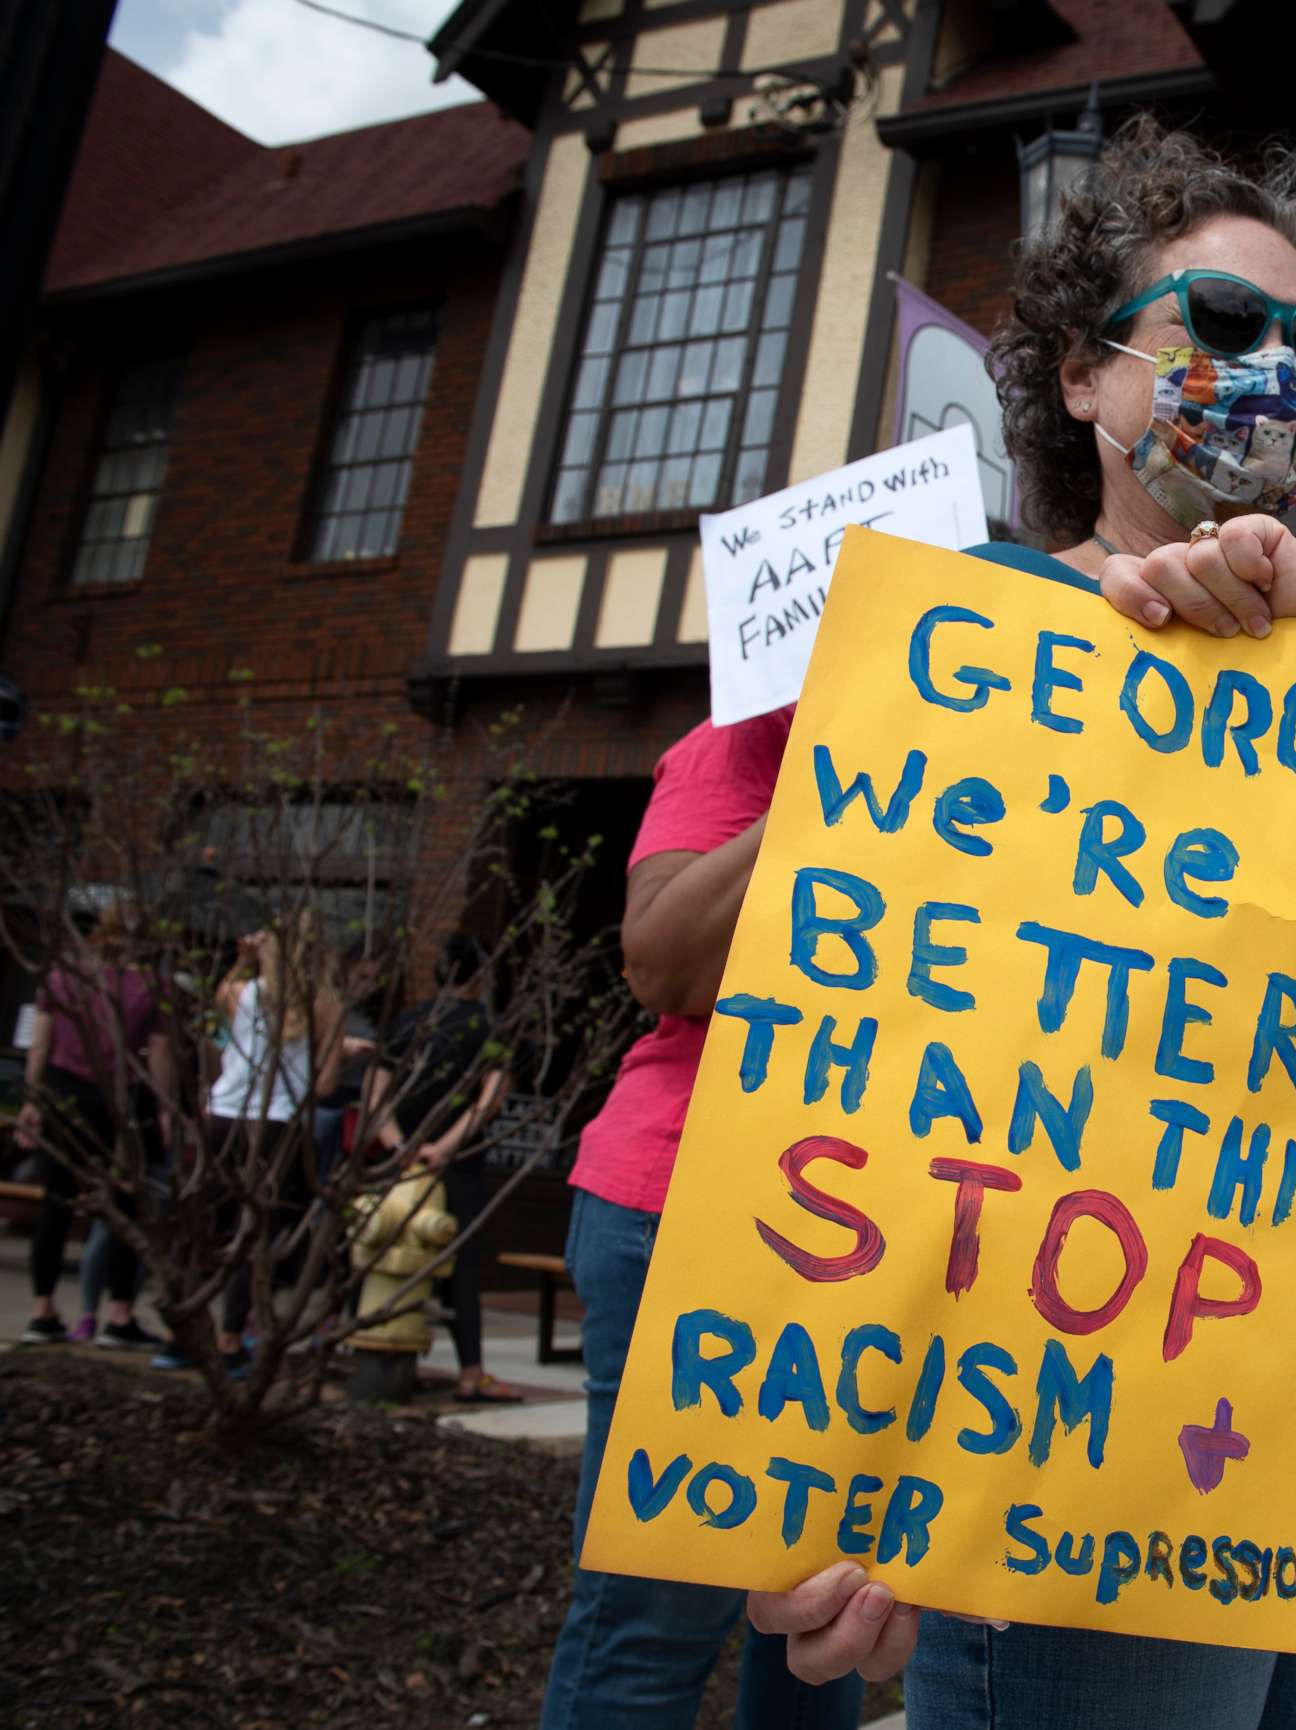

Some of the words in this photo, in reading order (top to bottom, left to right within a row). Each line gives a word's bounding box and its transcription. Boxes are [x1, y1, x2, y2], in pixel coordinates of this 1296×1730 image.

[720, 526, 763, 559] We
[714, 993, 1095, 1172] THAN
[754, 1134, 1263, 1364] STOP
[670, 1308, 1116, 1470] RACISM
[626, 1448, 946, 1568] VOTER
